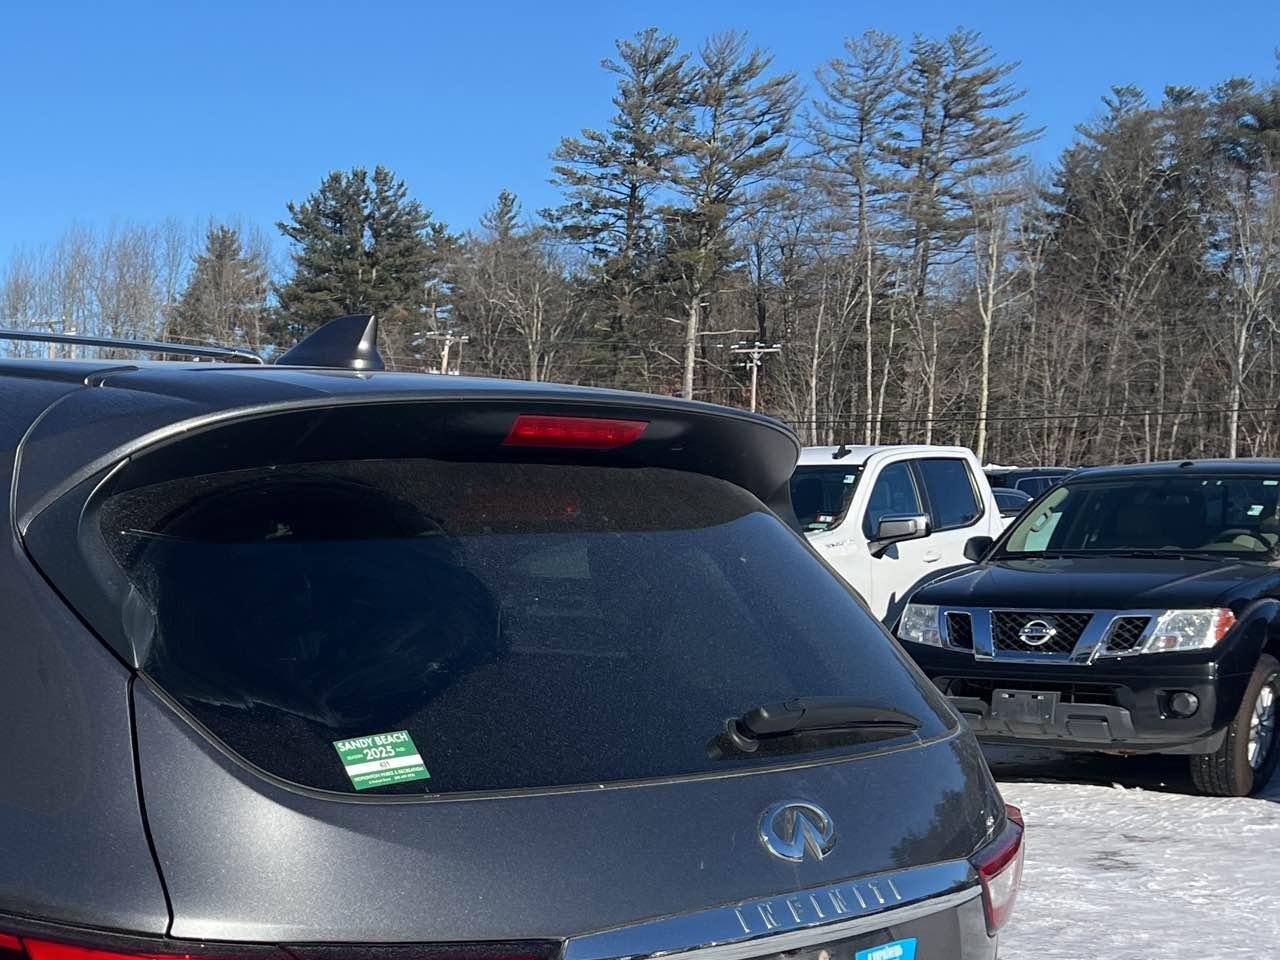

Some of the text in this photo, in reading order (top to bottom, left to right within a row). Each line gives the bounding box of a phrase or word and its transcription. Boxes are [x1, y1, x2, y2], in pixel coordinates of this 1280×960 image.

[337, 732, 409, 752] SANDY BEACH
[363, 745, 395, 760] 2025
[734, 879, 902, 934] INFINITI
